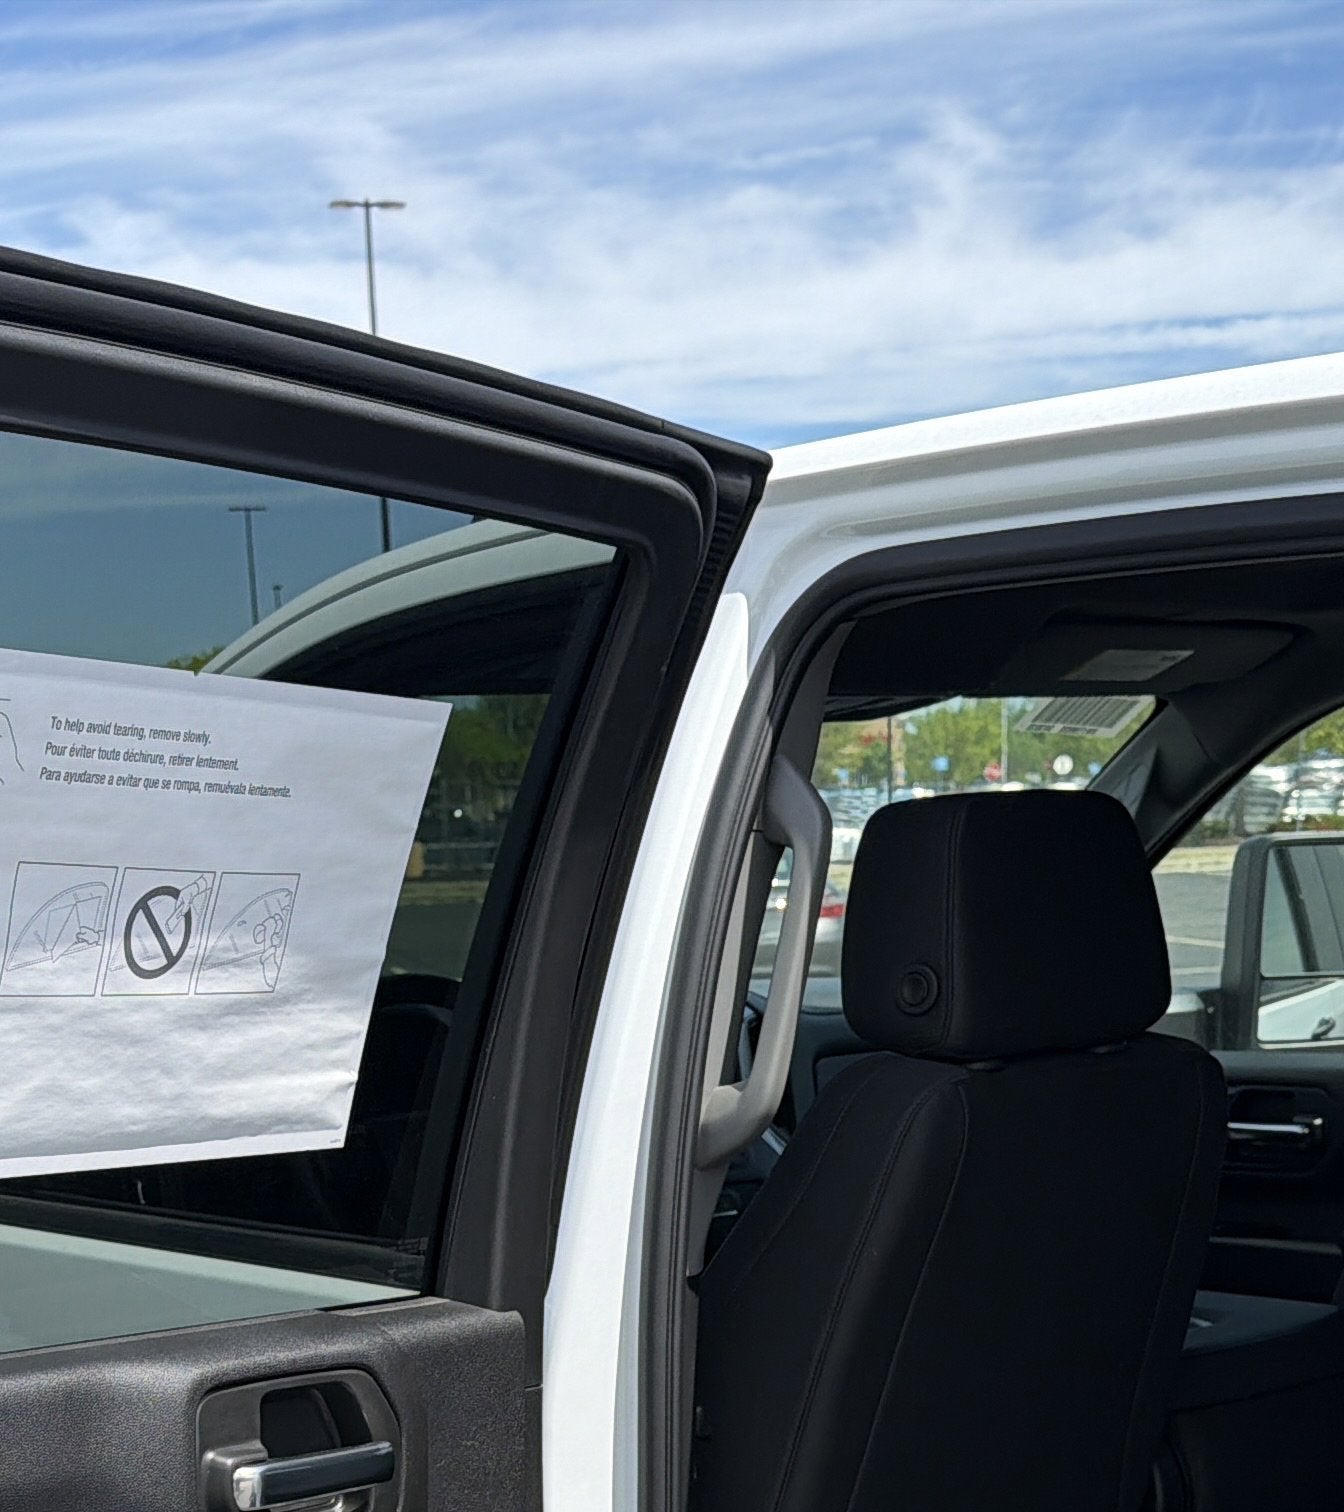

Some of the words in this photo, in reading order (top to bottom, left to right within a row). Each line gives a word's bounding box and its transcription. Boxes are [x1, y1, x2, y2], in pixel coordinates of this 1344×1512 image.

[51, 716, 62, 730] To
[64, 717, 85, 735] help
[86, 721, 112, 735] avoid
[113, 722, 146, 740] tearing,
[149, 727, 181, 740] remove
[182, 729, 211, 746] slowly.
[45, 742, 67, 756] Pour
[68, 743, 96, 759] éviter
[97, 746, 121, 761] toute
[122, 748, 166, 767] déchirure,
[168, 753, 195, 767] retirer
[195, 755, 239, 771] lentement.
[40, 766, 61, 781] Para
[63, 770, 106, 785] ayudarse
[107, 774, 114, 785] a
[116, 773, 141, 787] evitar
[143, 776, 159, 790] que
[161, 779, 171, 789] se
[173, 780, 201, 794] rompa,
[203, 780, 246, 795] remuévala
[247, 782, 291, 798] lentamente.
